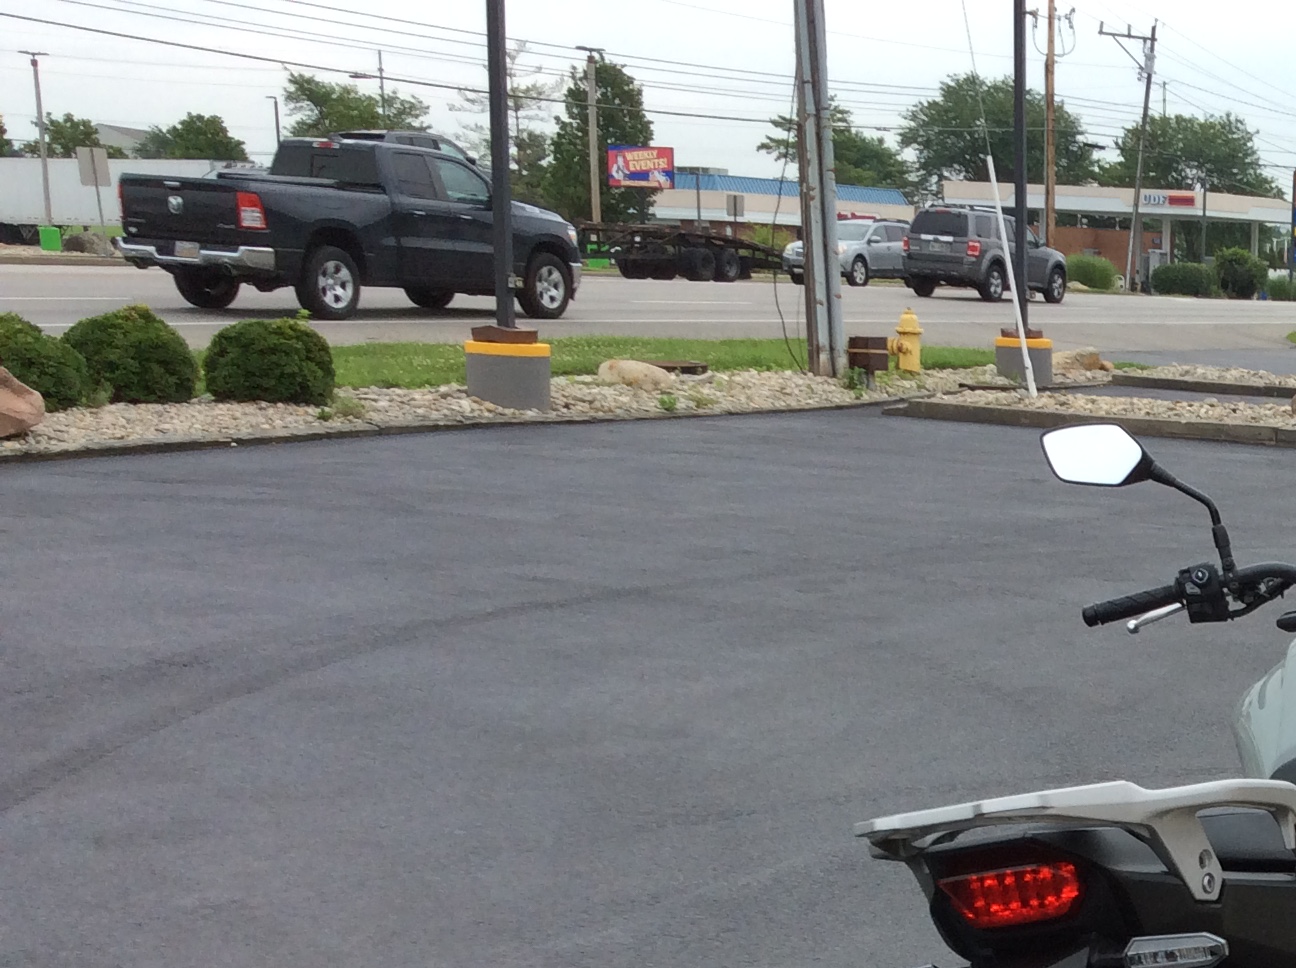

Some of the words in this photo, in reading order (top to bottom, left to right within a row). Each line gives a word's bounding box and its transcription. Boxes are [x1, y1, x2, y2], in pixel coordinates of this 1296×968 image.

[625, 150, 658, 161] WEEKLY
[629, 158, 668, 171] EVENTS!
[1143, 194, 1167, 205] UDF
